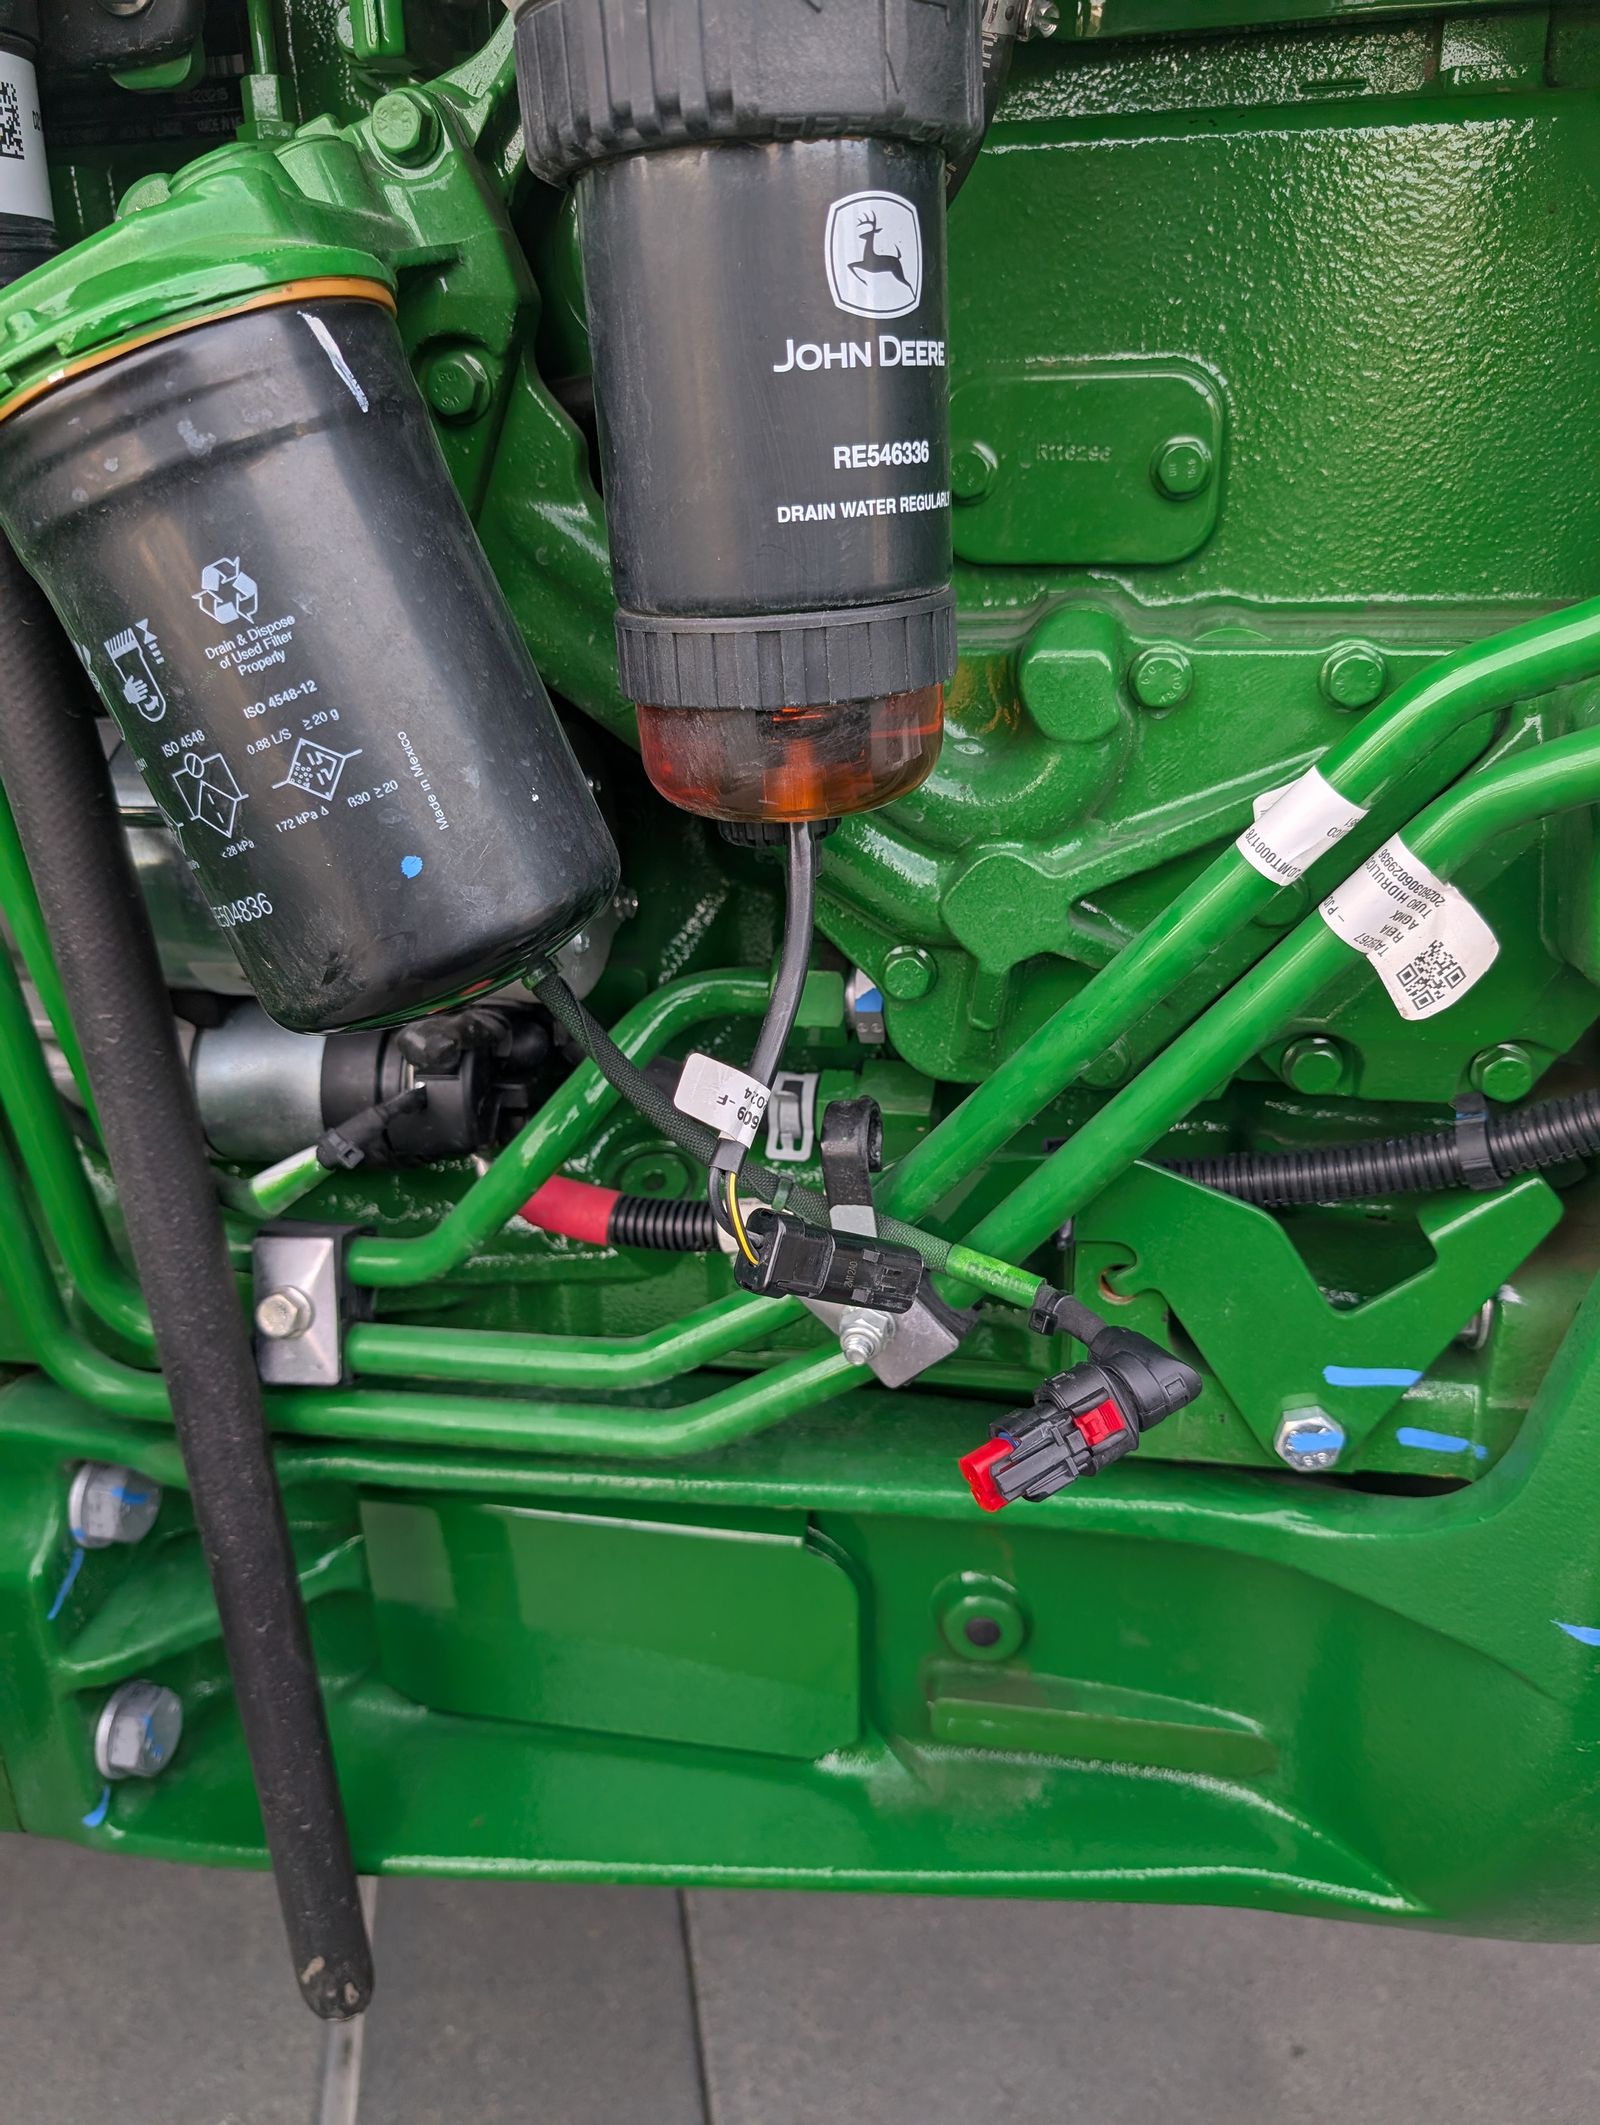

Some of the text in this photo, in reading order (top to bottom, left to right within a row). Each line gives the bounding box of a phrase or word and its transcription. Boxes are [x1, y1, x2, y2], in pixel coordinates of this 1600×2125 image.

[773, 335, 945, 373] JOHN DEERE
[833, 440, 930, 470] RE546336
[777, 503, 836, 524] DRAIN
[840, 498, 897, 519] WATER
[205, 615, 296, 660] Drain & Dispose
[219, 631, 293, 670] of Used Filter
[238, 650, 286, 676] Properly
[242, 679, 318, 720] ISO 4548-12
[329, 708, 340, 721] g
[161, 729, 206, 758] ISO 4548
[246, 737, 271, 755] 0.88
[397, 731, 450, 831] Made in Mexico
[275, 819, 296, 833] 172
[296, 810, 319, 825] kPa
[237, 840, 255, 853] kPa
[1406, 899, 1433, 919] TUBO
